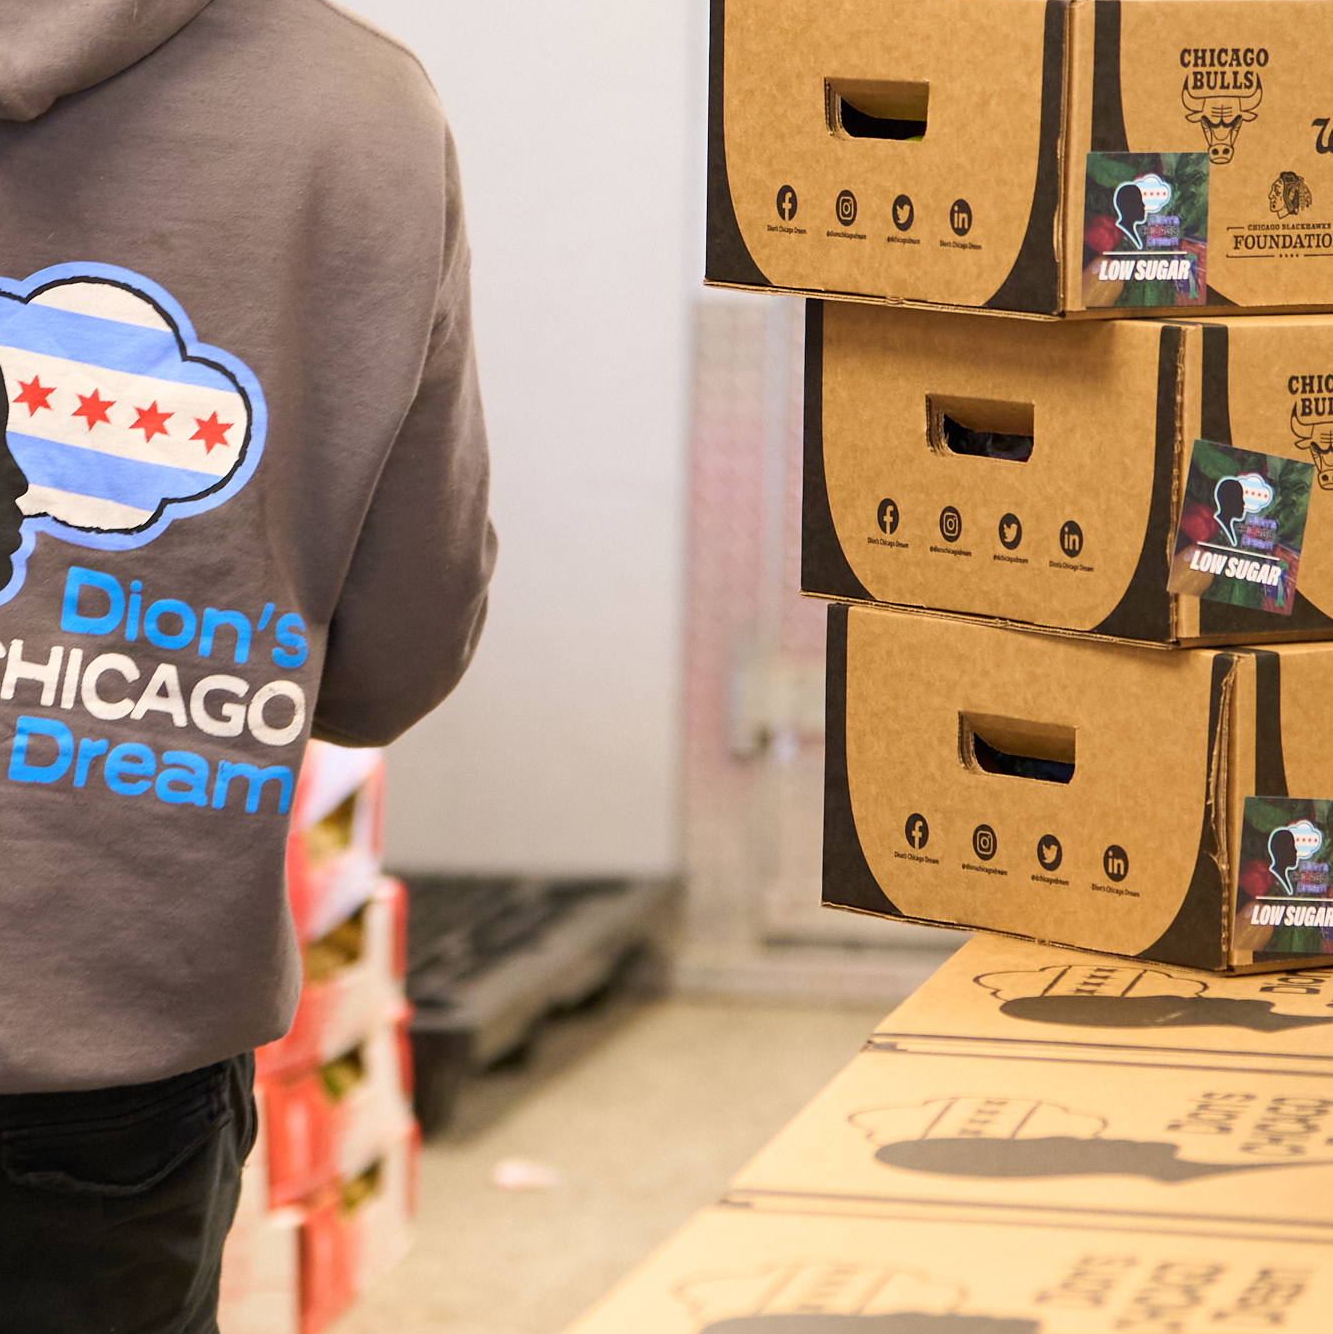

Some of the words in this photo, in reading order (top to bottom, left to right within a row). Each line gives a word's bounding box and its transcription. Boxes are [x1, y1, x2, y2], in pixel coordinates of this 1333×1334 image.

[1179, 47, 1269, 68] CHICAGO
[1192, 70, 1254, 90] BULLS
[1247, 224, 1280, 232] CHICAGO
[1281, 222, 1332, 231] BLACKHAWKS
[1233, 233, 1333, 250] FOUNDATIO
[1098, 260, 1136, 281] LOW
[1133, 259, 1191, 281] SUGAR
[1287, 373, 1333, 396] CHIC
[1189, 550, 1228, 575] LOW
[1224, 557, 1282, 587] SUGAR
[60, 566, 309, 668] Dion's
[8, 715, 294, 814] Dream
[1250, 904, 1286, 926] LOW
